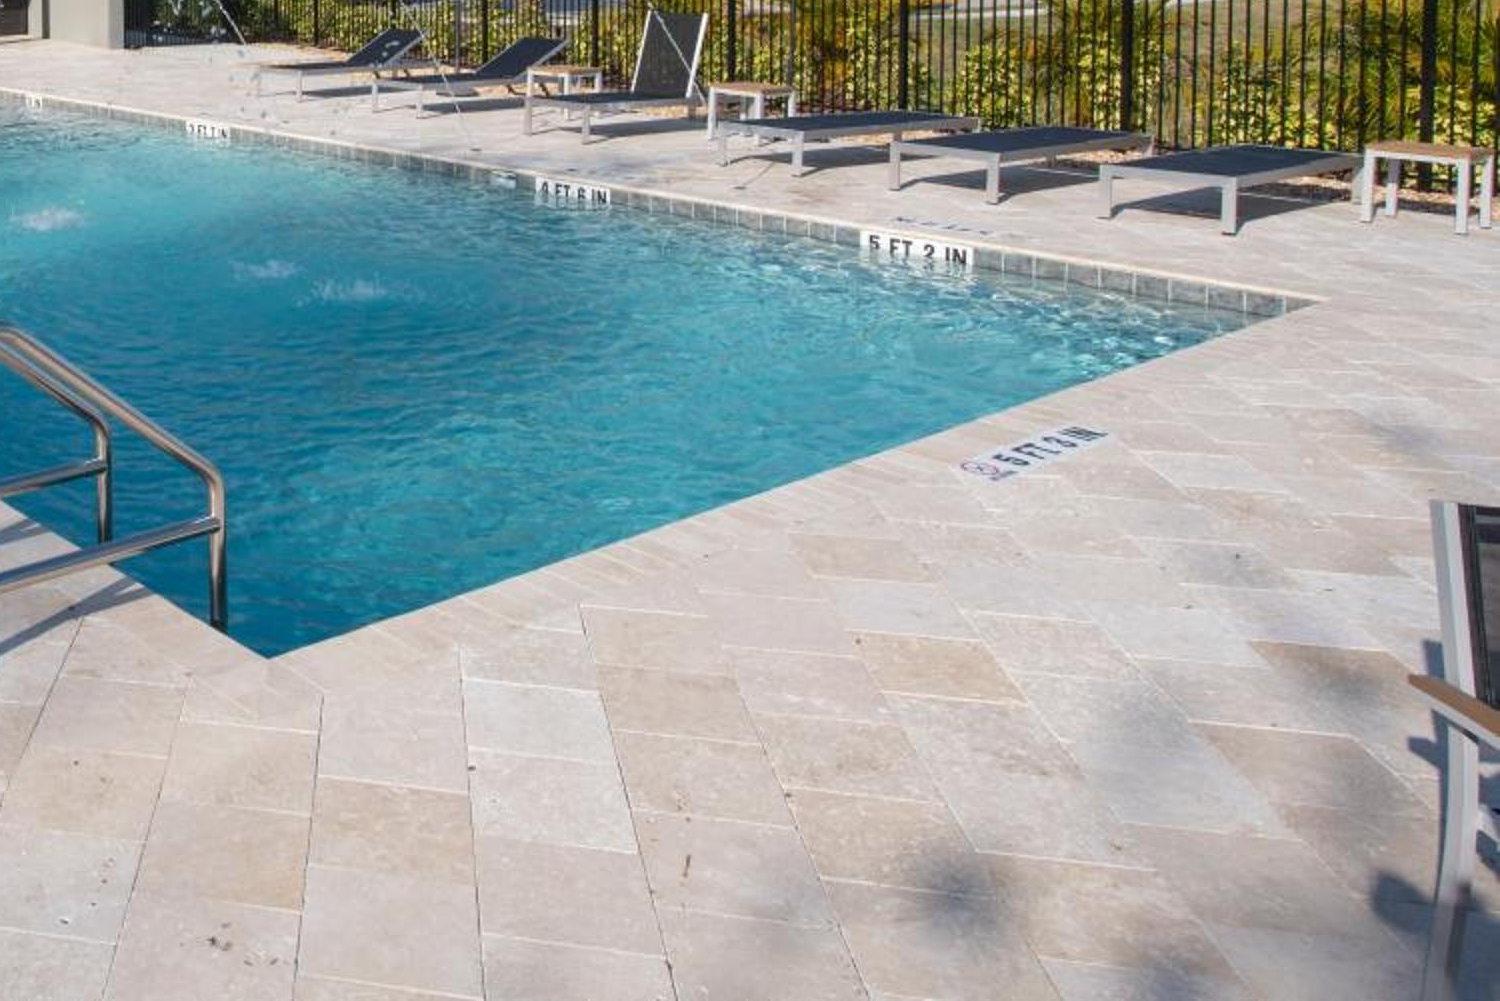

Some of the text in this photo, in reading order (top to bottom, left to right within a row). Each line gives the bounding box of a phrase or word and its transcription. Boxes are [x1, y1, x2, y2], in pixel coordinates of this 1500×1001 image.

[555, 182, 571, 199] FT
[591, 188, 607, 204] IN
[868, 234, 967, 265] 5 FT 2 IN
[992, 453, 1031, 466] 5
[1011, 442, 1062, 459] FT
